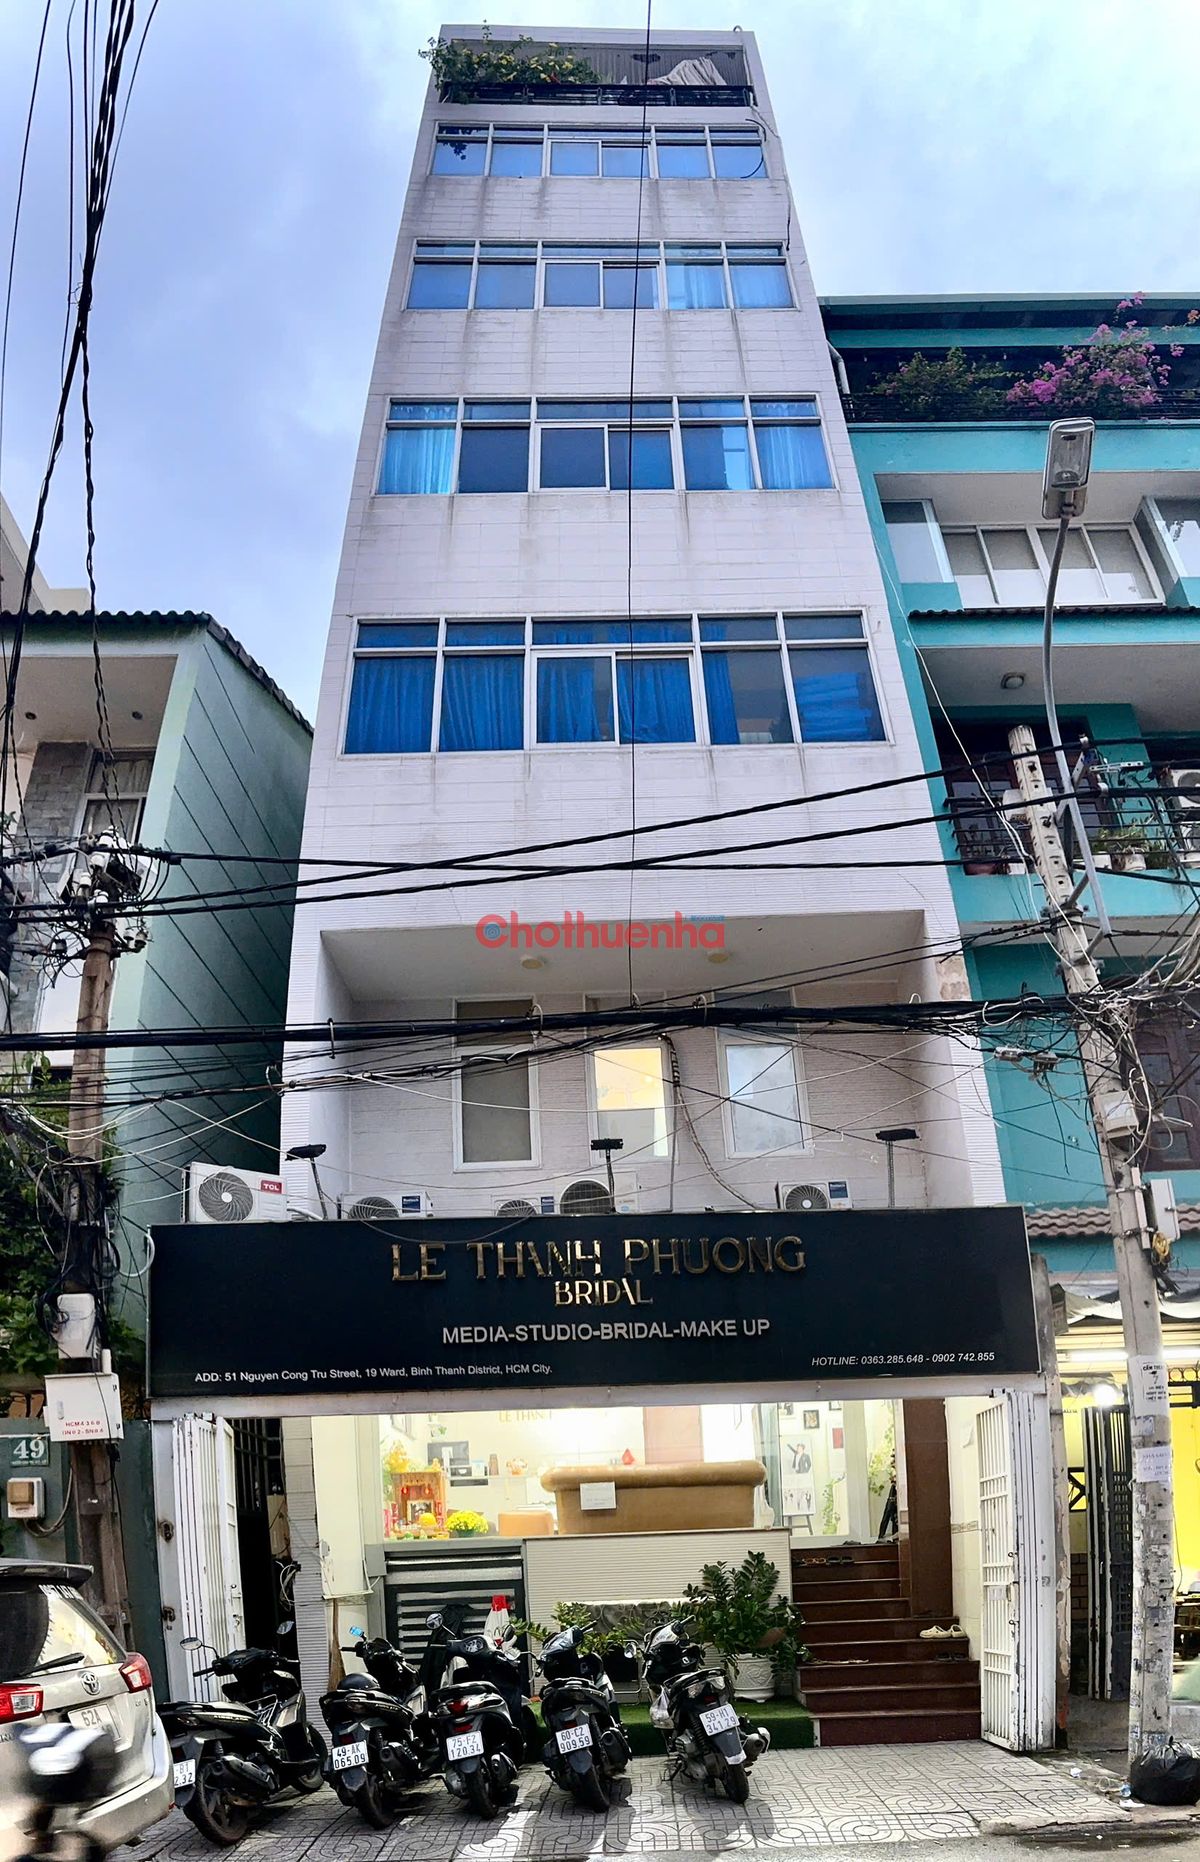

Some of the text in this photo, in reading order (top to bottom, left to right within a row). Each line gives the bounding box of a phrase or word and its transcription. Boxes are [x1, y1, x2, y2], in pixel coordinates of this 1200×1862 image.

[263, 1183, 280, 1191] TCL
[391, 1235, 807, 1281] LE THANH PHUONG
[555, 1278, 653, 1307] BRIDAL
[442, 1318, 770, 1344] MEDIA-STUDIO-BRIDAL-MAKE UP
[811, 1356, 859, 1366] HOTLINE:
[860, 1354, 924, 1365] 0363.285.648
[932, 1353, 955, 1363] 0902
[957, 1352, 995, 1362] 742.855
[194, 1363, 552, 1383] ADD: 51 Nguyen Cong Tru Street, 19 Ward, Binh Thanh District, HCM City.
[13, 1439, 45, 1459] 49
[705, 1708, 729, 1723] 59-H1
[706, 1718, 737, 1734] 341.29
[452, 1735, 477, 1748] 75-F2
[561, 1727, 585, 1741] 60-C2
[336, 1745, 362, 1758] 49-AK
[450, 1745, 481, 1759] 120.34
[559, 1737, 591, 1753] 909.59
[174, 1773, 193, 1786] 2.32
